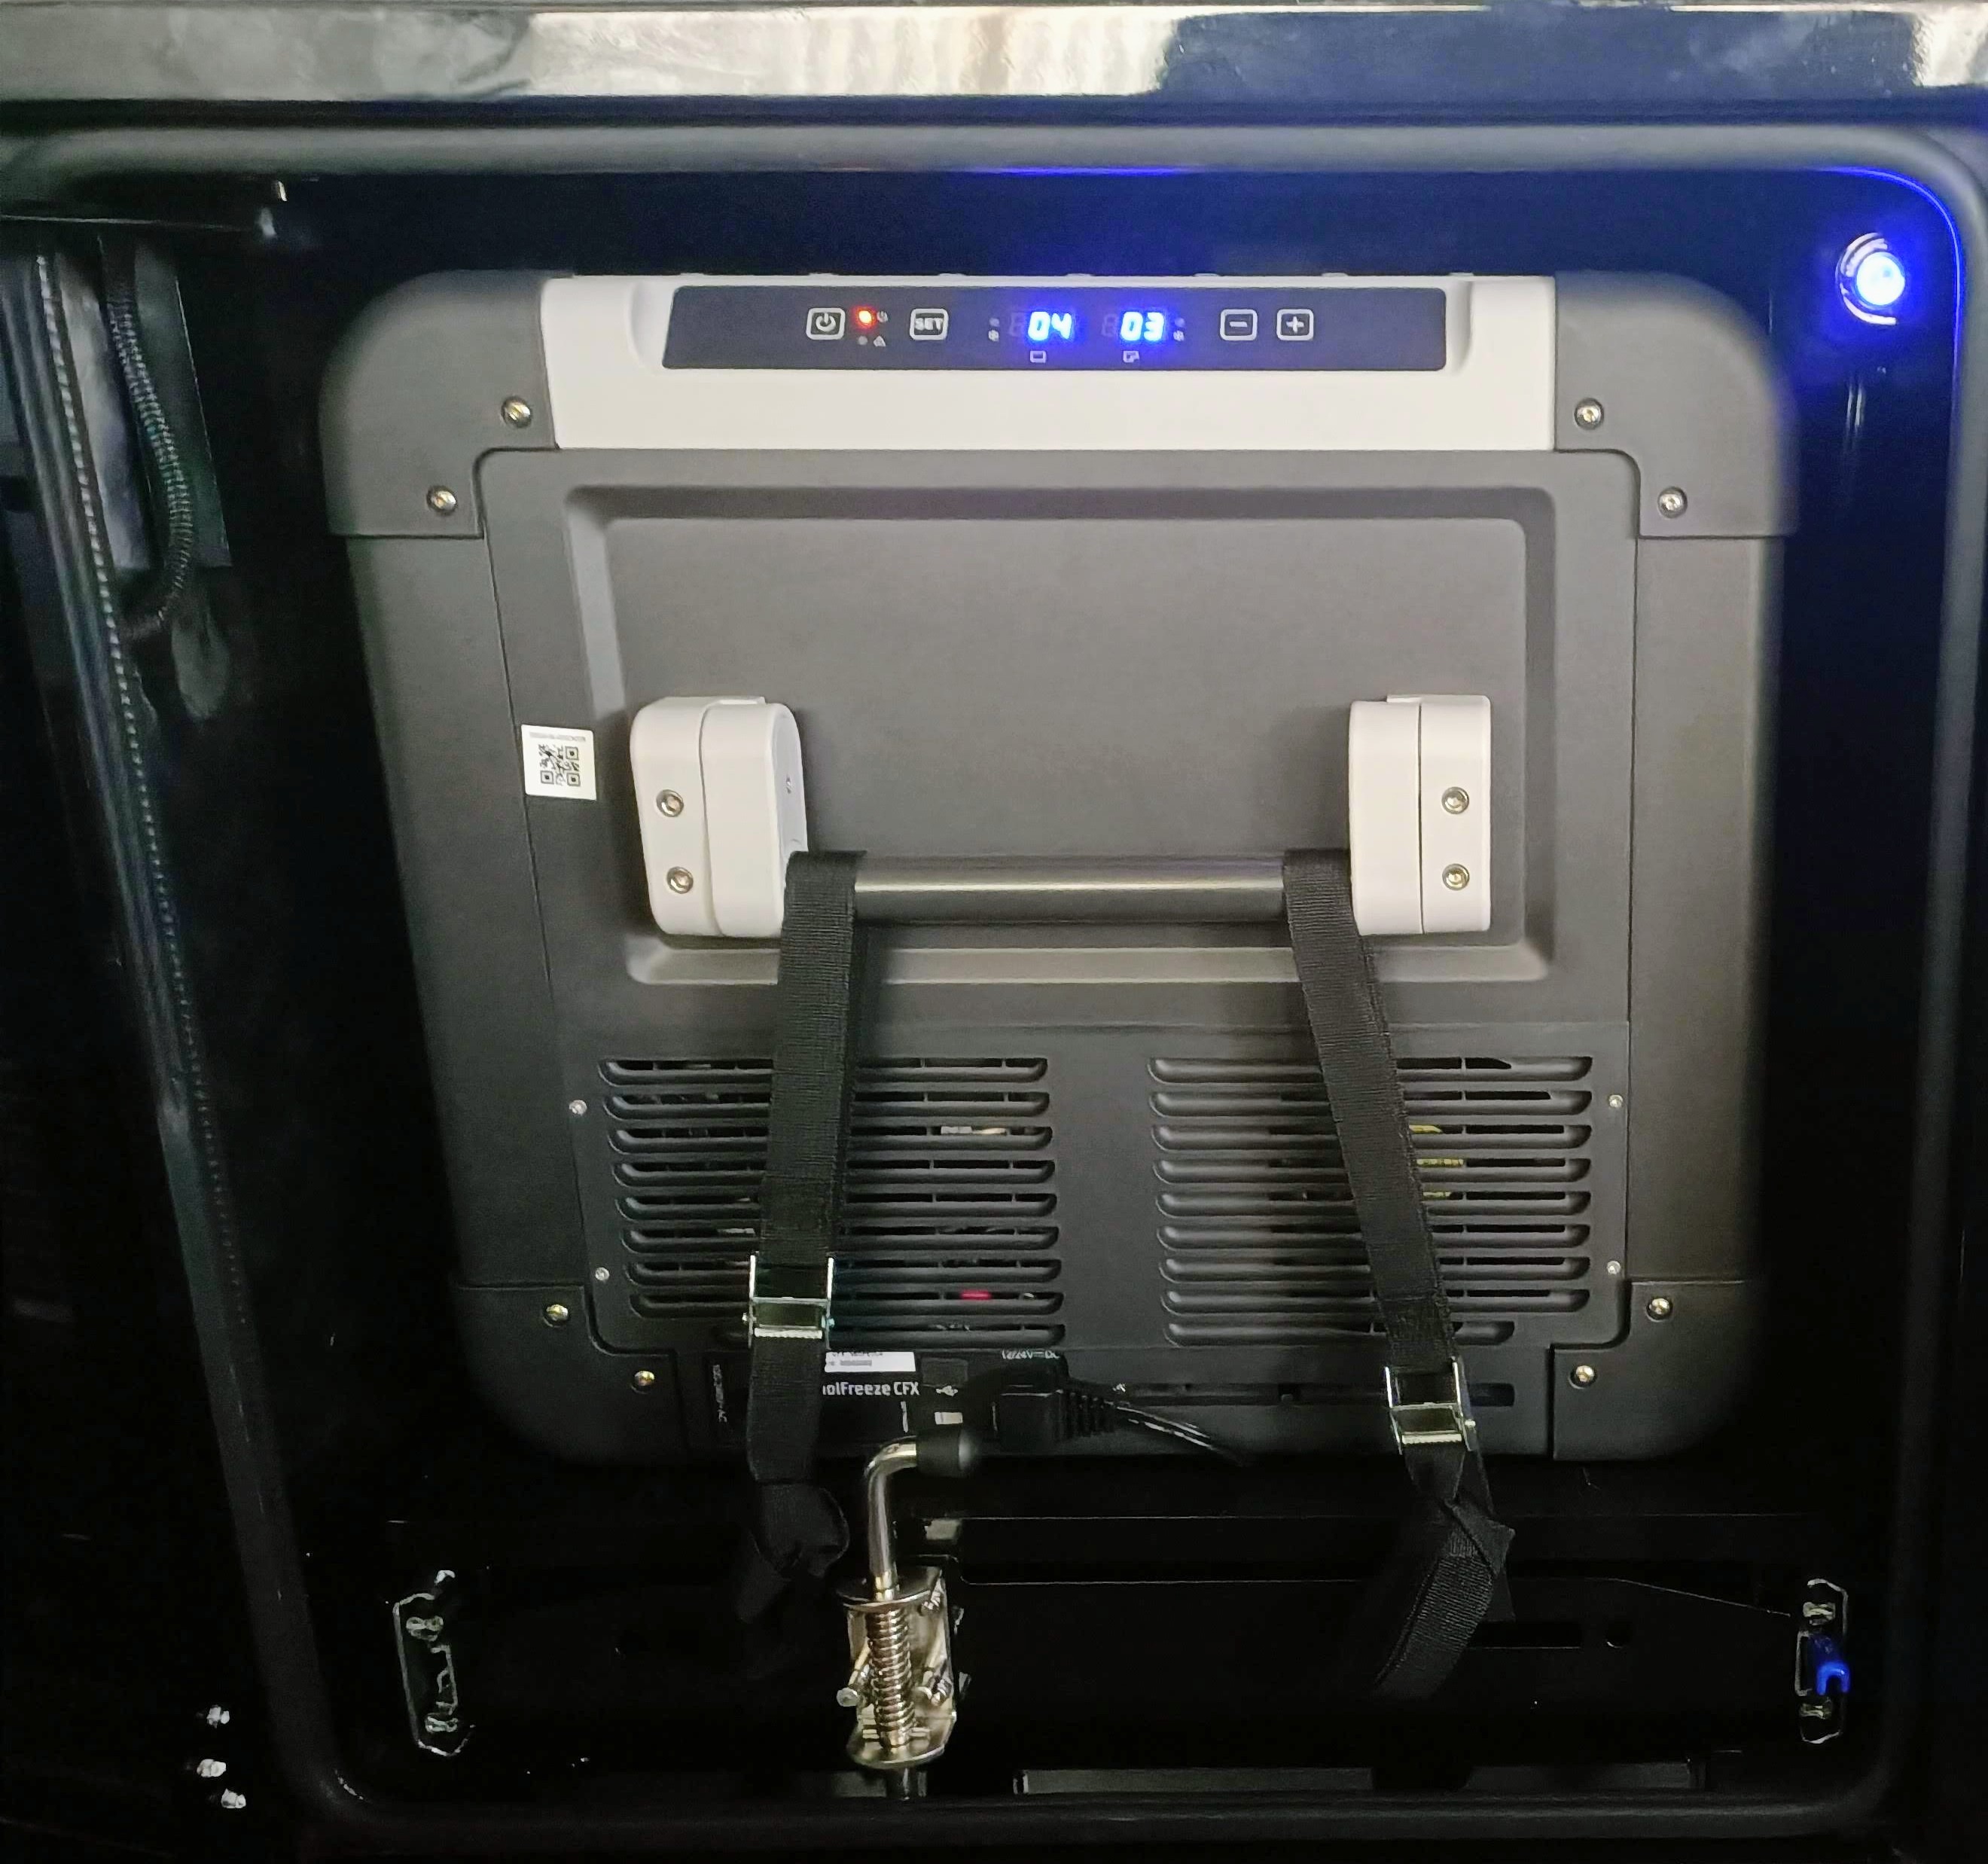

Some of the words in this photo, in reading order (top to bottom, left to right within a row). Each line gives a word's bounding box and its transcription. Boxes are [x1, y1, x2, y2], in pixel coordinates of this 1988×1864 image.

[915, 317, 943, 331] SET
[1027, 311, 1072, 340] 04
[1120, 311, 1165, 341] 03
[893, 1381, 919, 1396] CFX
